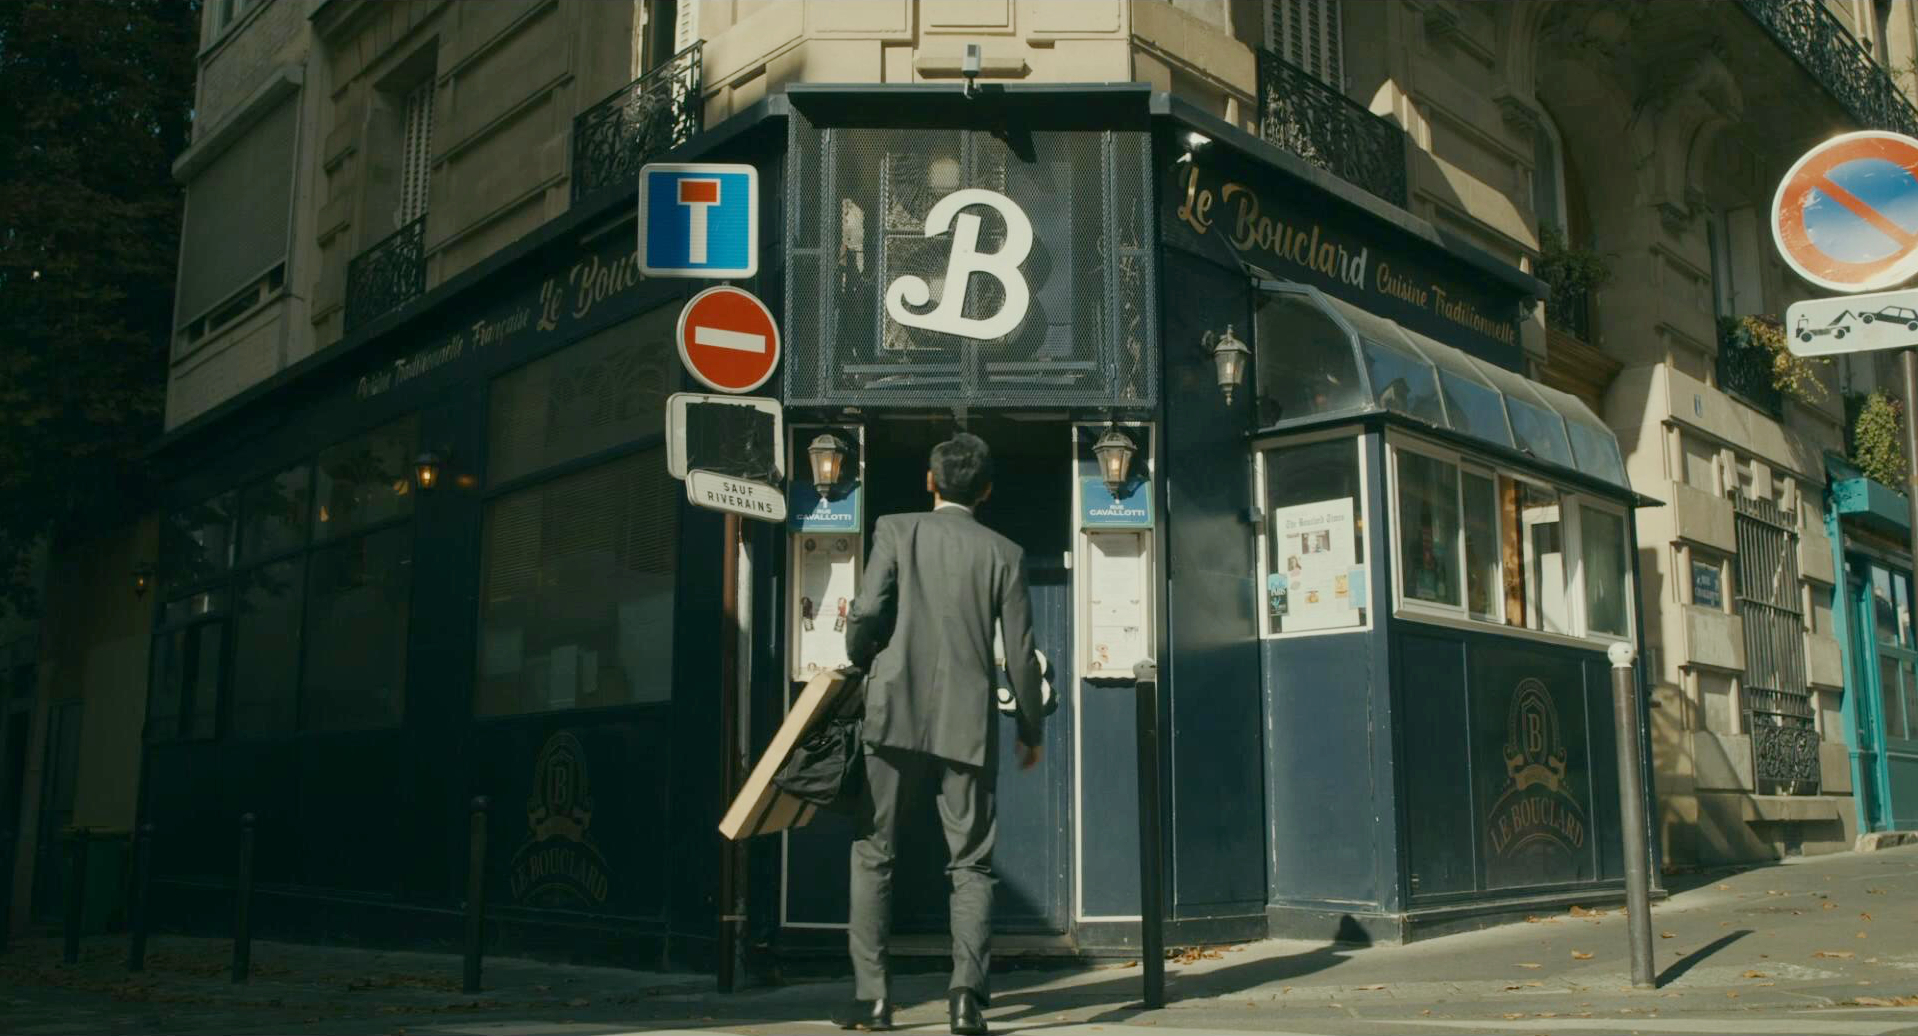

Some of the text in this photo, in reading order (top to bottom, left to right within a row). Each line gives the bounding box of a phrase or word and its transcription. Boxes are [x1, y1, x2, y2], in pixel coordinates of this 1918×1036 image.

[886, 188, 1033, 340] B
[1176, 164, 1516, 346] Le Bouclard Cuisine Traditionnelle
[536, 279, 562, 331] Le
[569, 251, 645, 319] Bouc
[707, 491, 772, 513] RIVERAINS
[723, 482, 753, 496] SAUF
[796, 513, 853, 521] CAVALLOTTI
[1529, 713, 1543, 753] B
[1490, 797, 1584, 855] LE BOUCLARD
